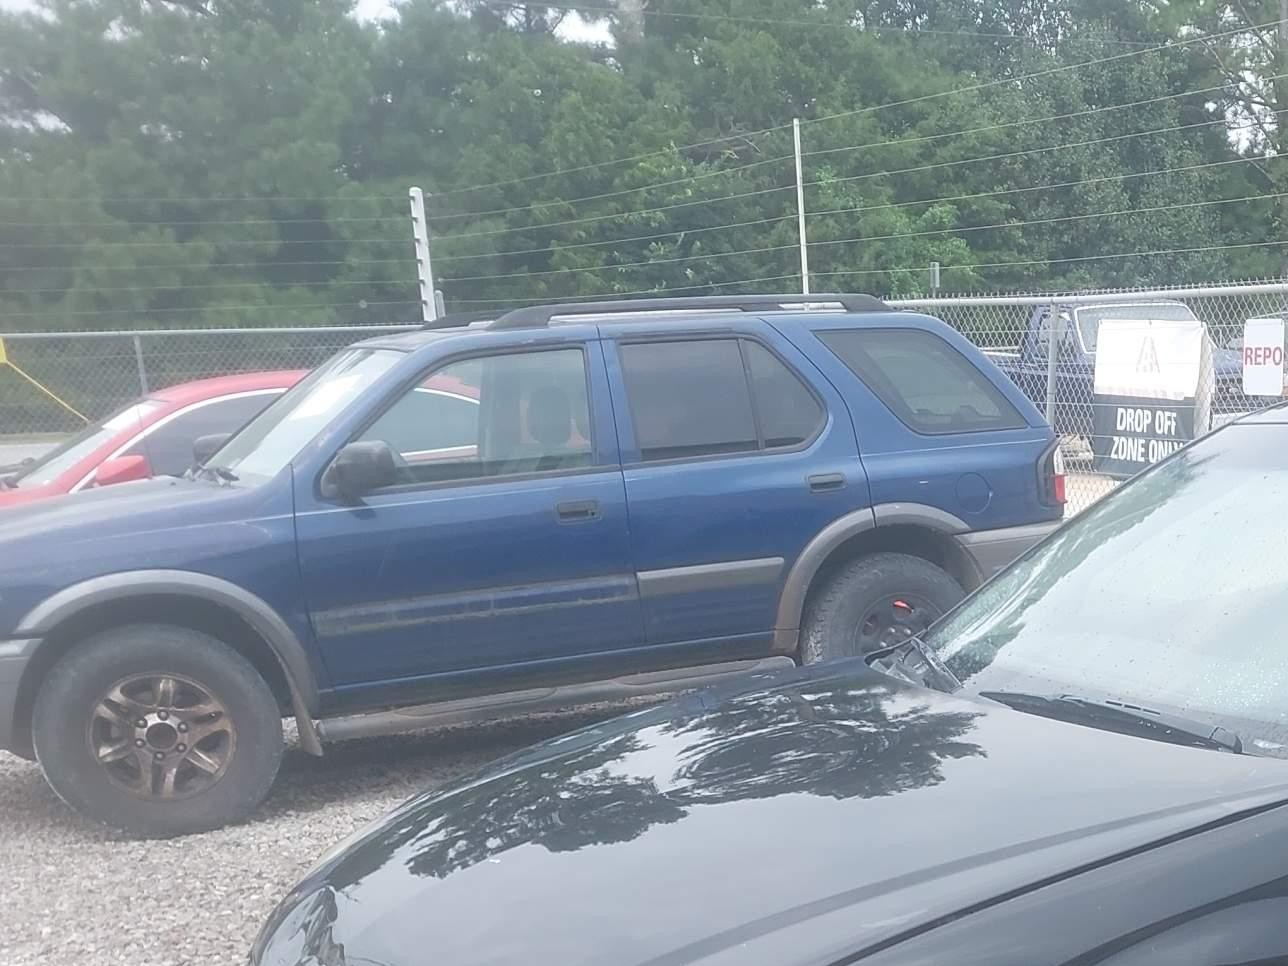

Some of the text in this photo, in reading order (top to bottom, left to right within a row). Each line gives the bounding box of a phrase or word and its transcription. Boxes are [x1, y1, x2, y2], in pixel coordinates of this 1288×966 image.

[1244, 346, 1283, 366] REPO
[1116, 407, 1177, 436] DROP OFF
[1110, 436, 1146, 463] ZONE
